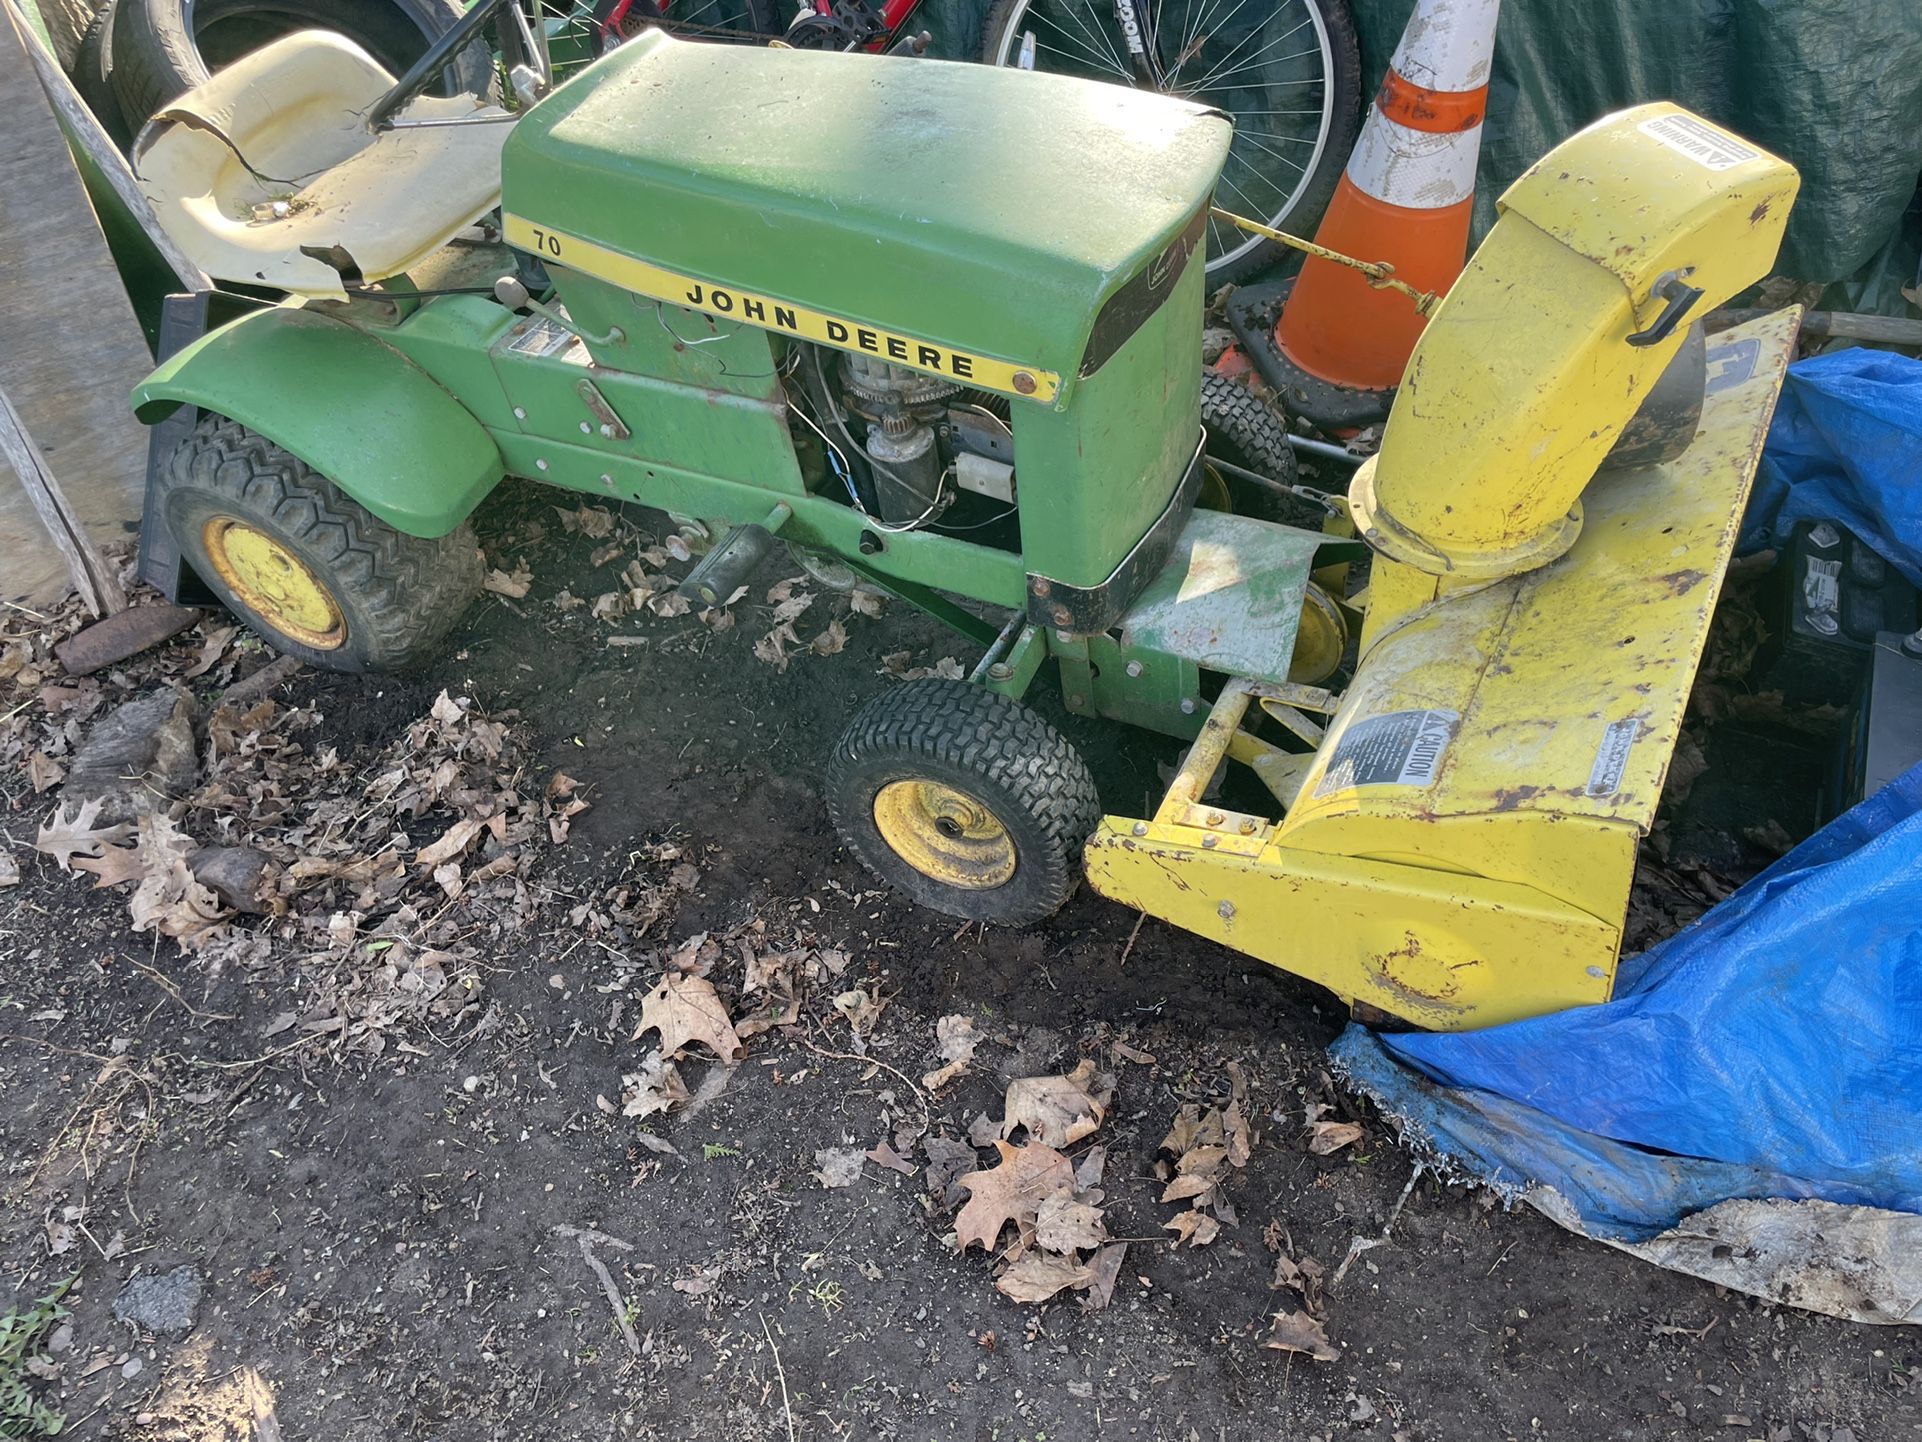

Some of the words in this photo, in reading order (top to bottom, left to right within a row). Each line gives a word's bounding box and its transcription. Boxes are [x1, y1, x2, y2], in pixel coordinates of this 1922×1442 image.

[1647, 120, 1712, 156] WARNING
[533, 229, 561, 257] 70
[686, 284, 797, 330] JOHN
[826, 320, 973, 379] DEERE
[1405, 733, 1441, 777] CAUTION
